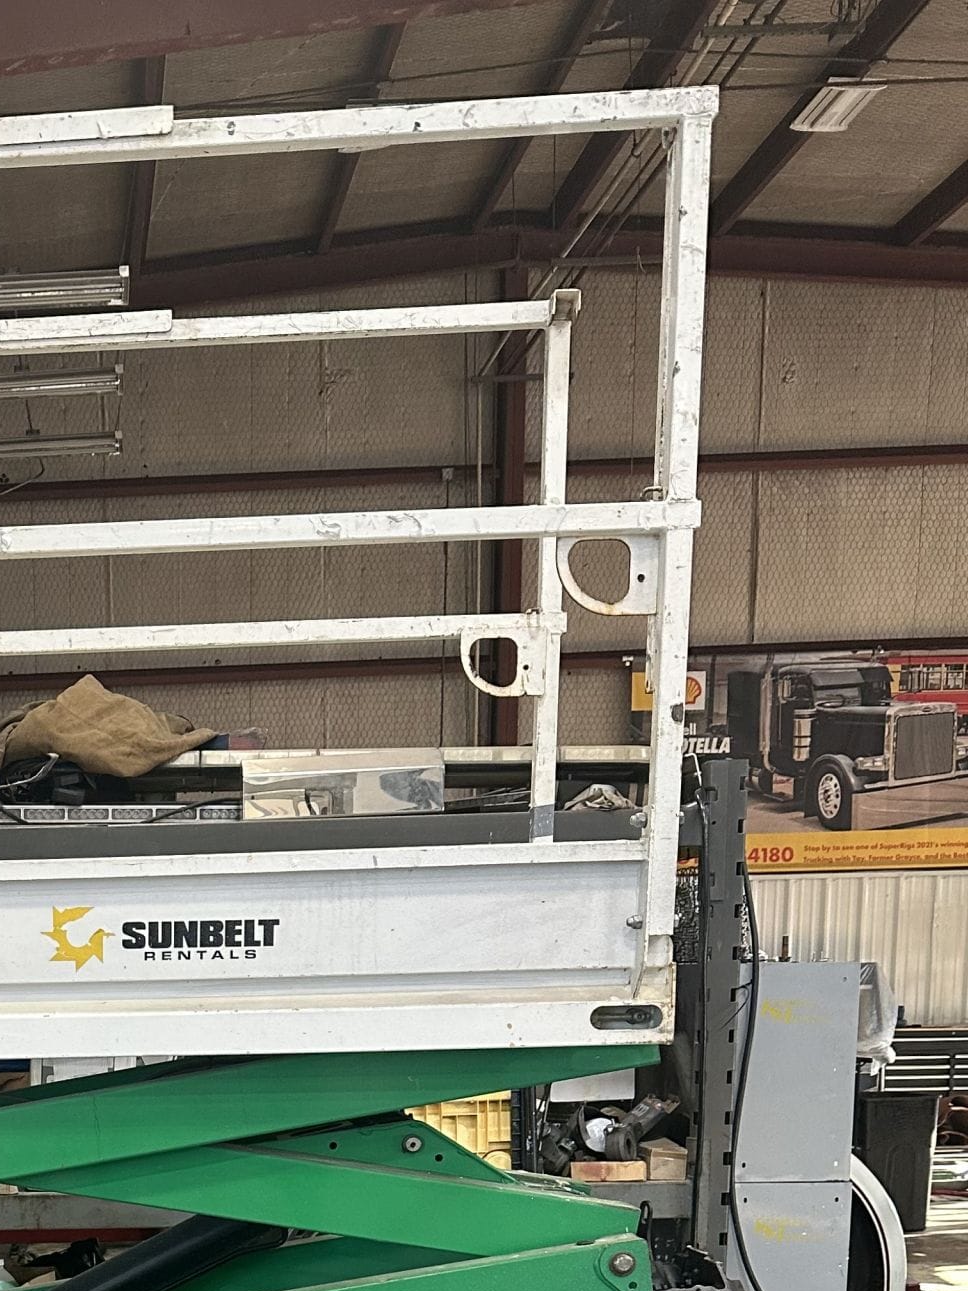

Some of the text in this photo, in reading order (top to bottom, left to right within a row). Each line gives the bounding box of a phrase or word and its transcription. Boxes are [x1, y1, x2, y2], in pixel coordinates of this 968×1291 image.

[683, 723, 696, 736] ell
[682, 737, 730, 753] TELLA
[747, 846, 794, 863] 4180
[822, 844, 831, 853] by
[871, 842, 878, 850] of
[122, 919, 280, 949] SUNBELT
[144, 949, 257, 961] RENTALS
